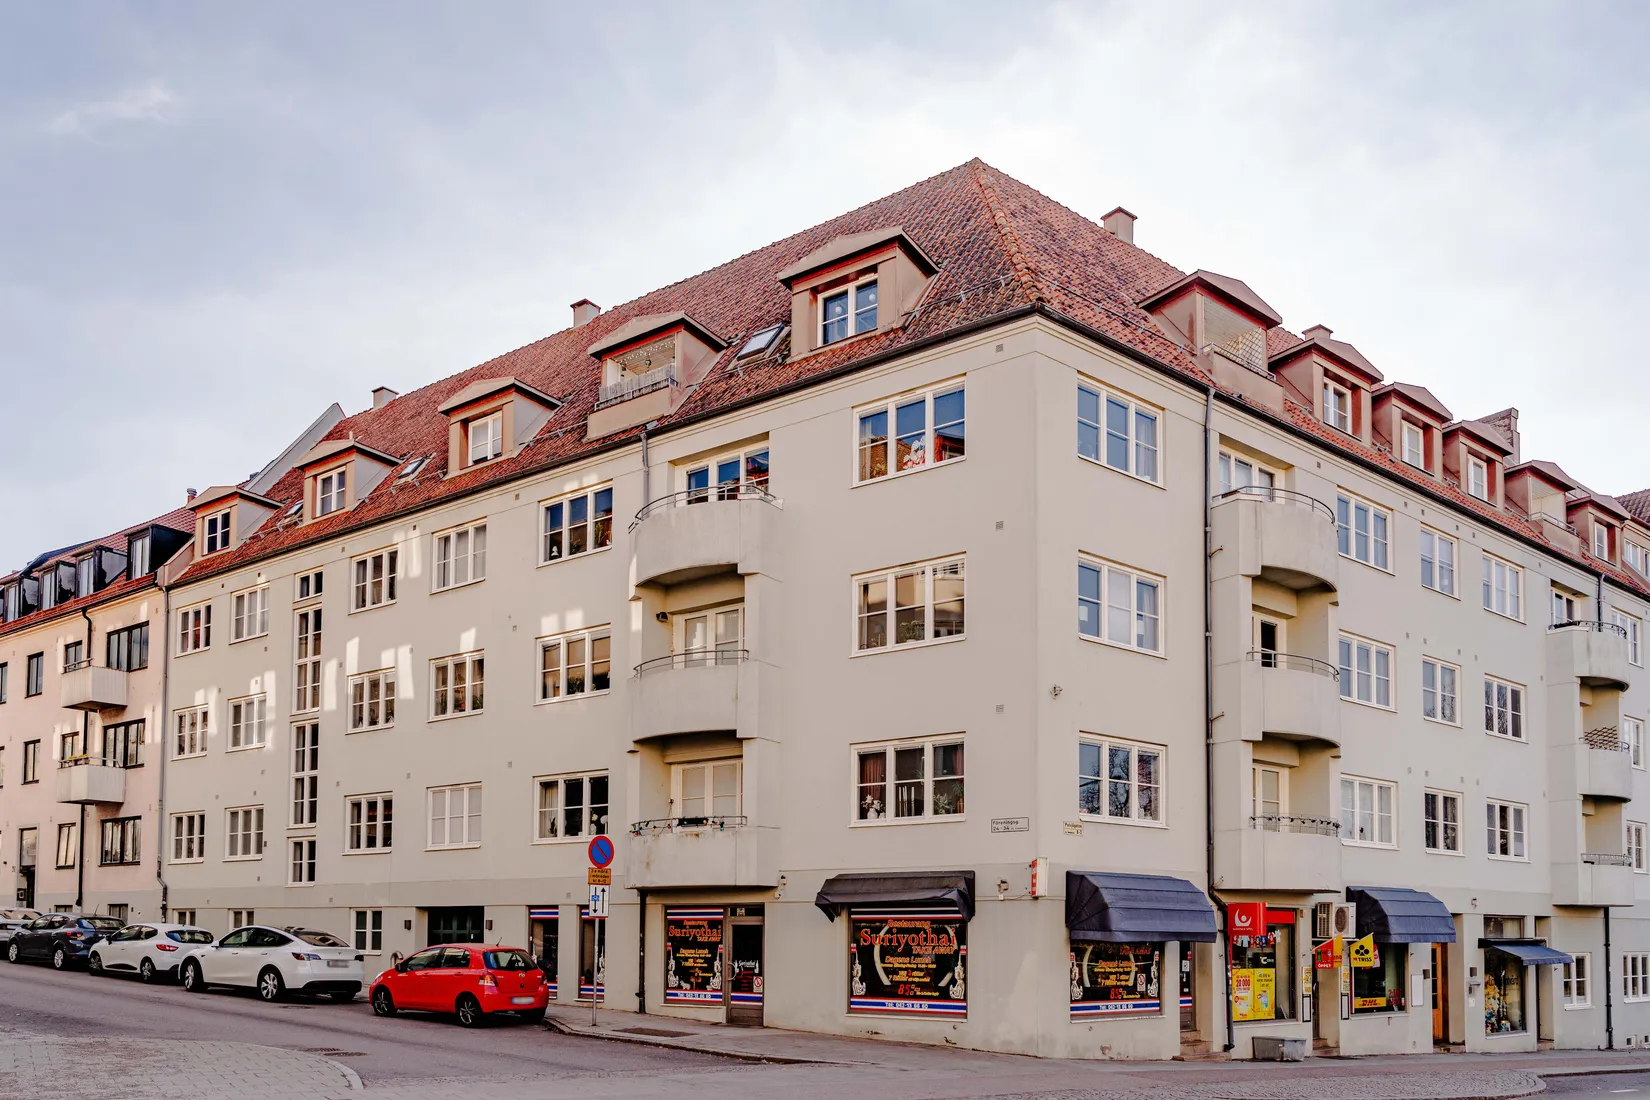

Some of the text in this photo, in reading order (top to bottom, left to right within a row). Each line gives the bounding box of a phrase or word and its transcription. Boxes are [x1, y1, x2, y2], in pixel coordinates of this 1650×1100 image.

[668, 925, 722, 940] Suriyothai
[860, 928, 956, 952] Suriyothai
[912, 946, 932, 954] TAKE
